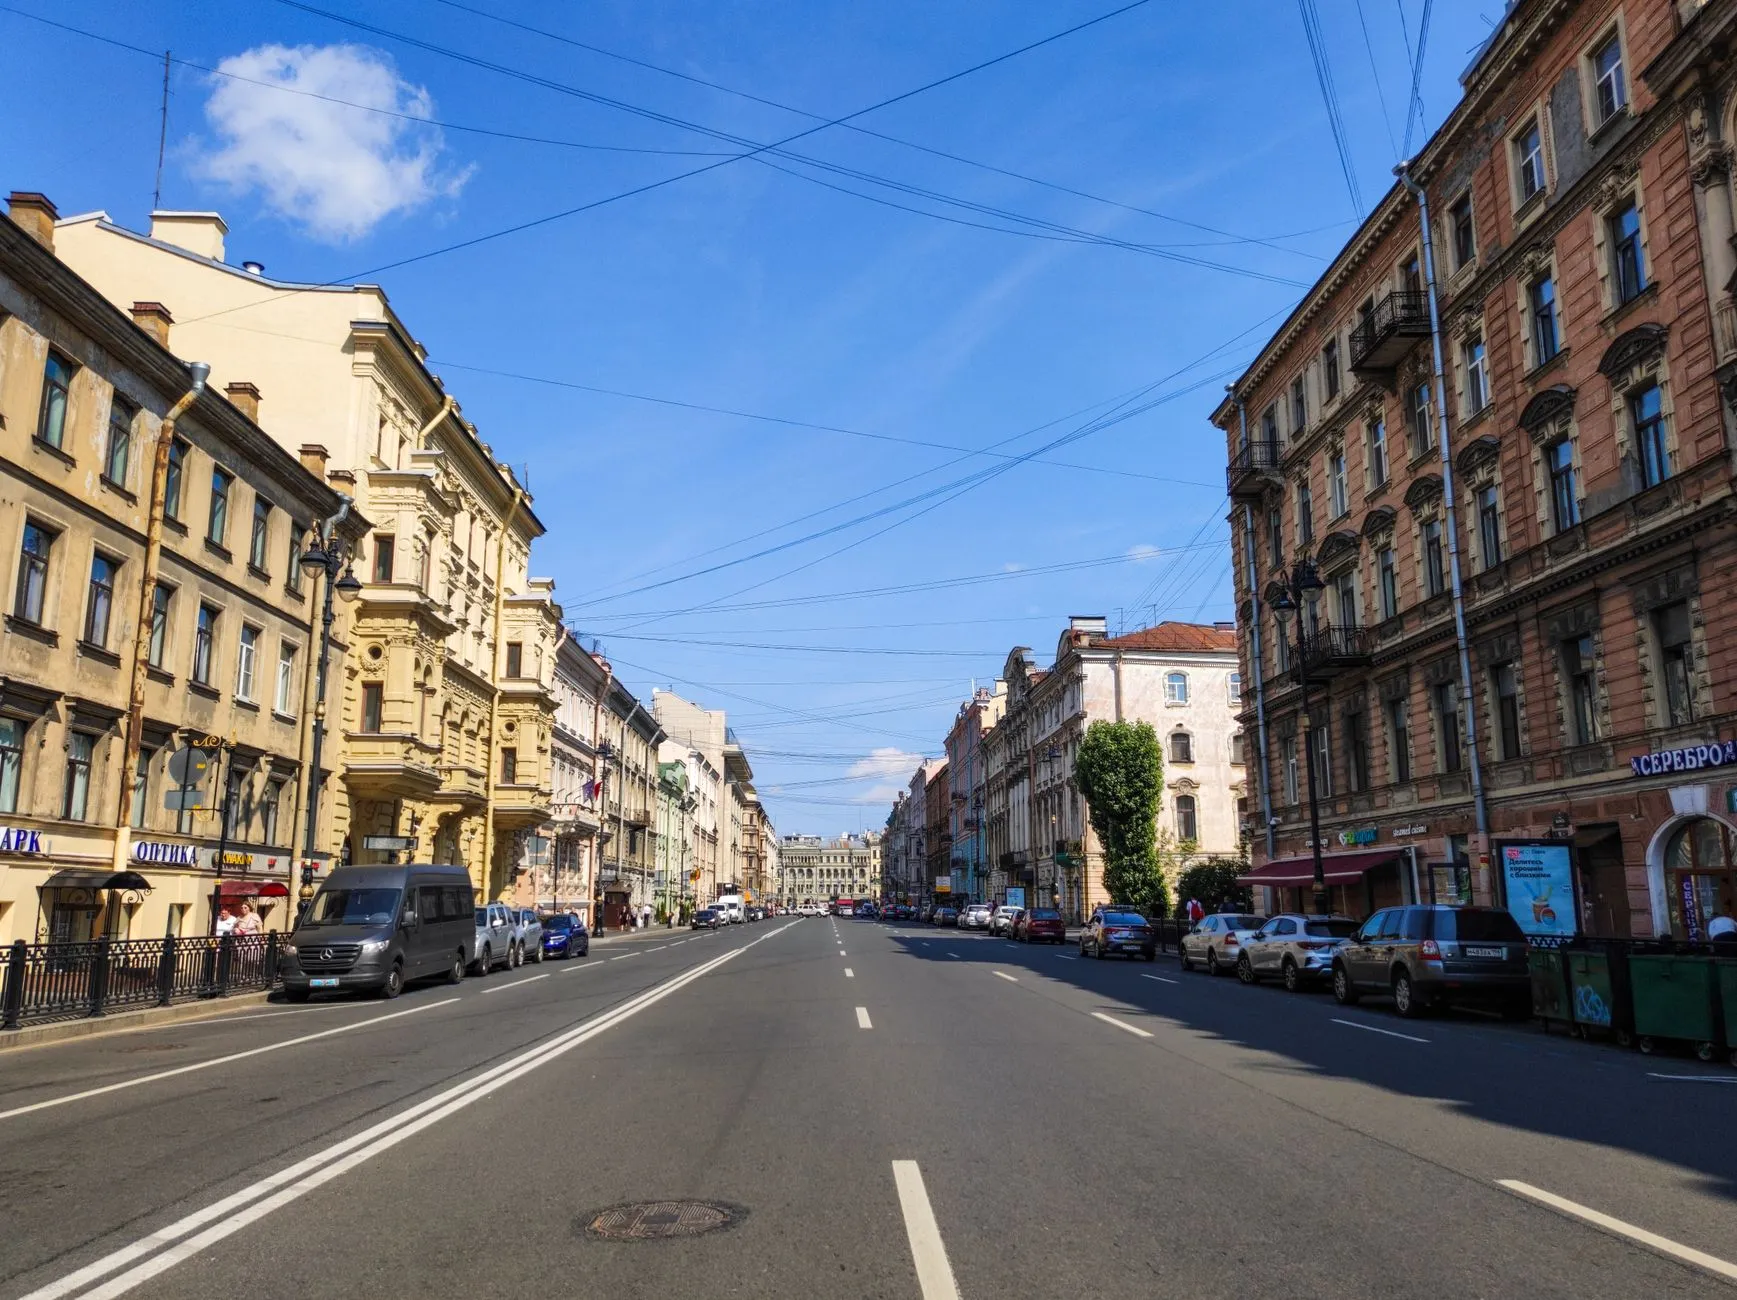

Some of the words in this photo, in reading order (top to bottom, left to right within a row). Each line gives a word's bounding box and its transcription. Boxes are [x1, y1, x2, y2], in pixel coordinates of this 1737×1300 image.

[1640, 744, 1723, 775] СЕРЕБРО
[0, 827, 42, 852] АРК
[136, 841, 197, 864] ОПТИКА
